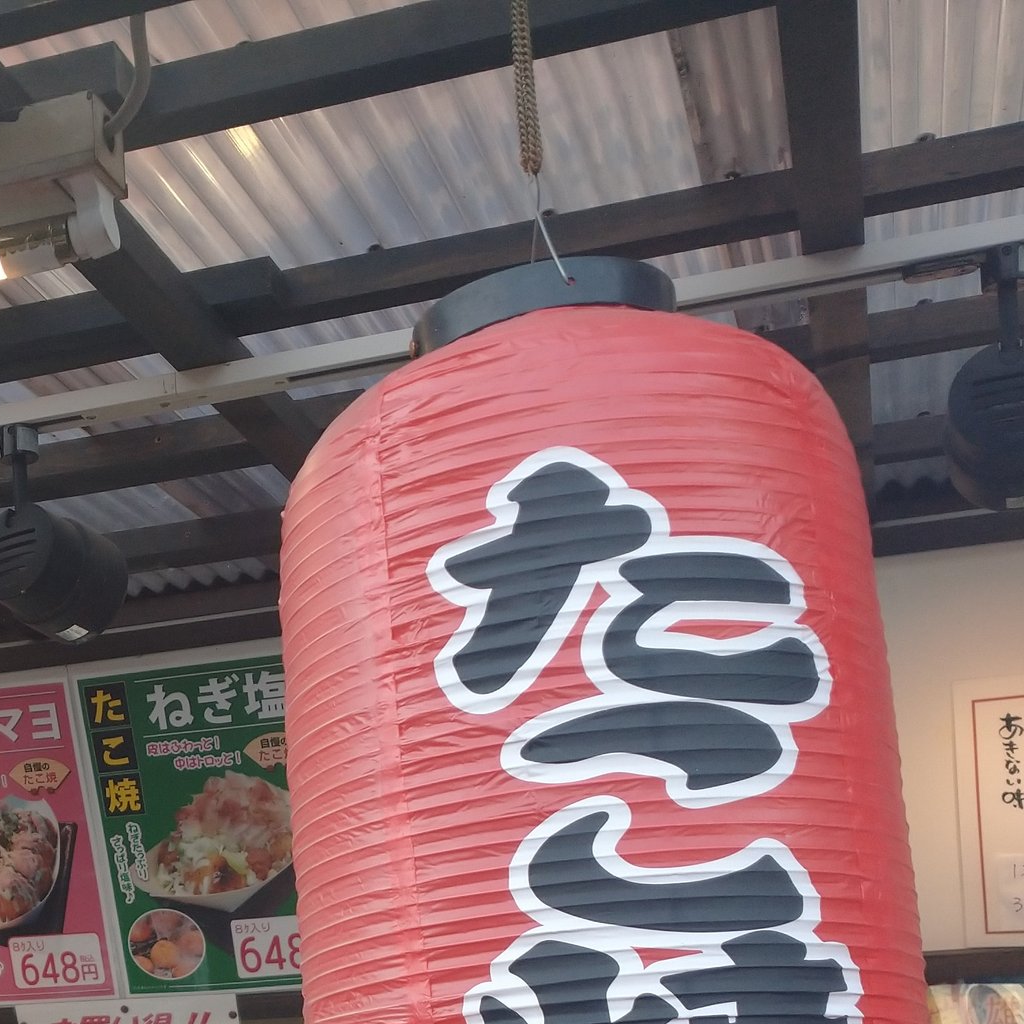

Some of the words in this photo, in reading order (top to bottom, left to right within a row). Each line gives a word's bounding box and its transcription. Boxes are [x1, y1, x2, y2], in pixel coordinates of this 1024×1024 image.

[146, 670, 285, 731] ねぎ塩
[23, 771, 58, 785] たこ焼
[91, 689, 143, 814] たこ焼
